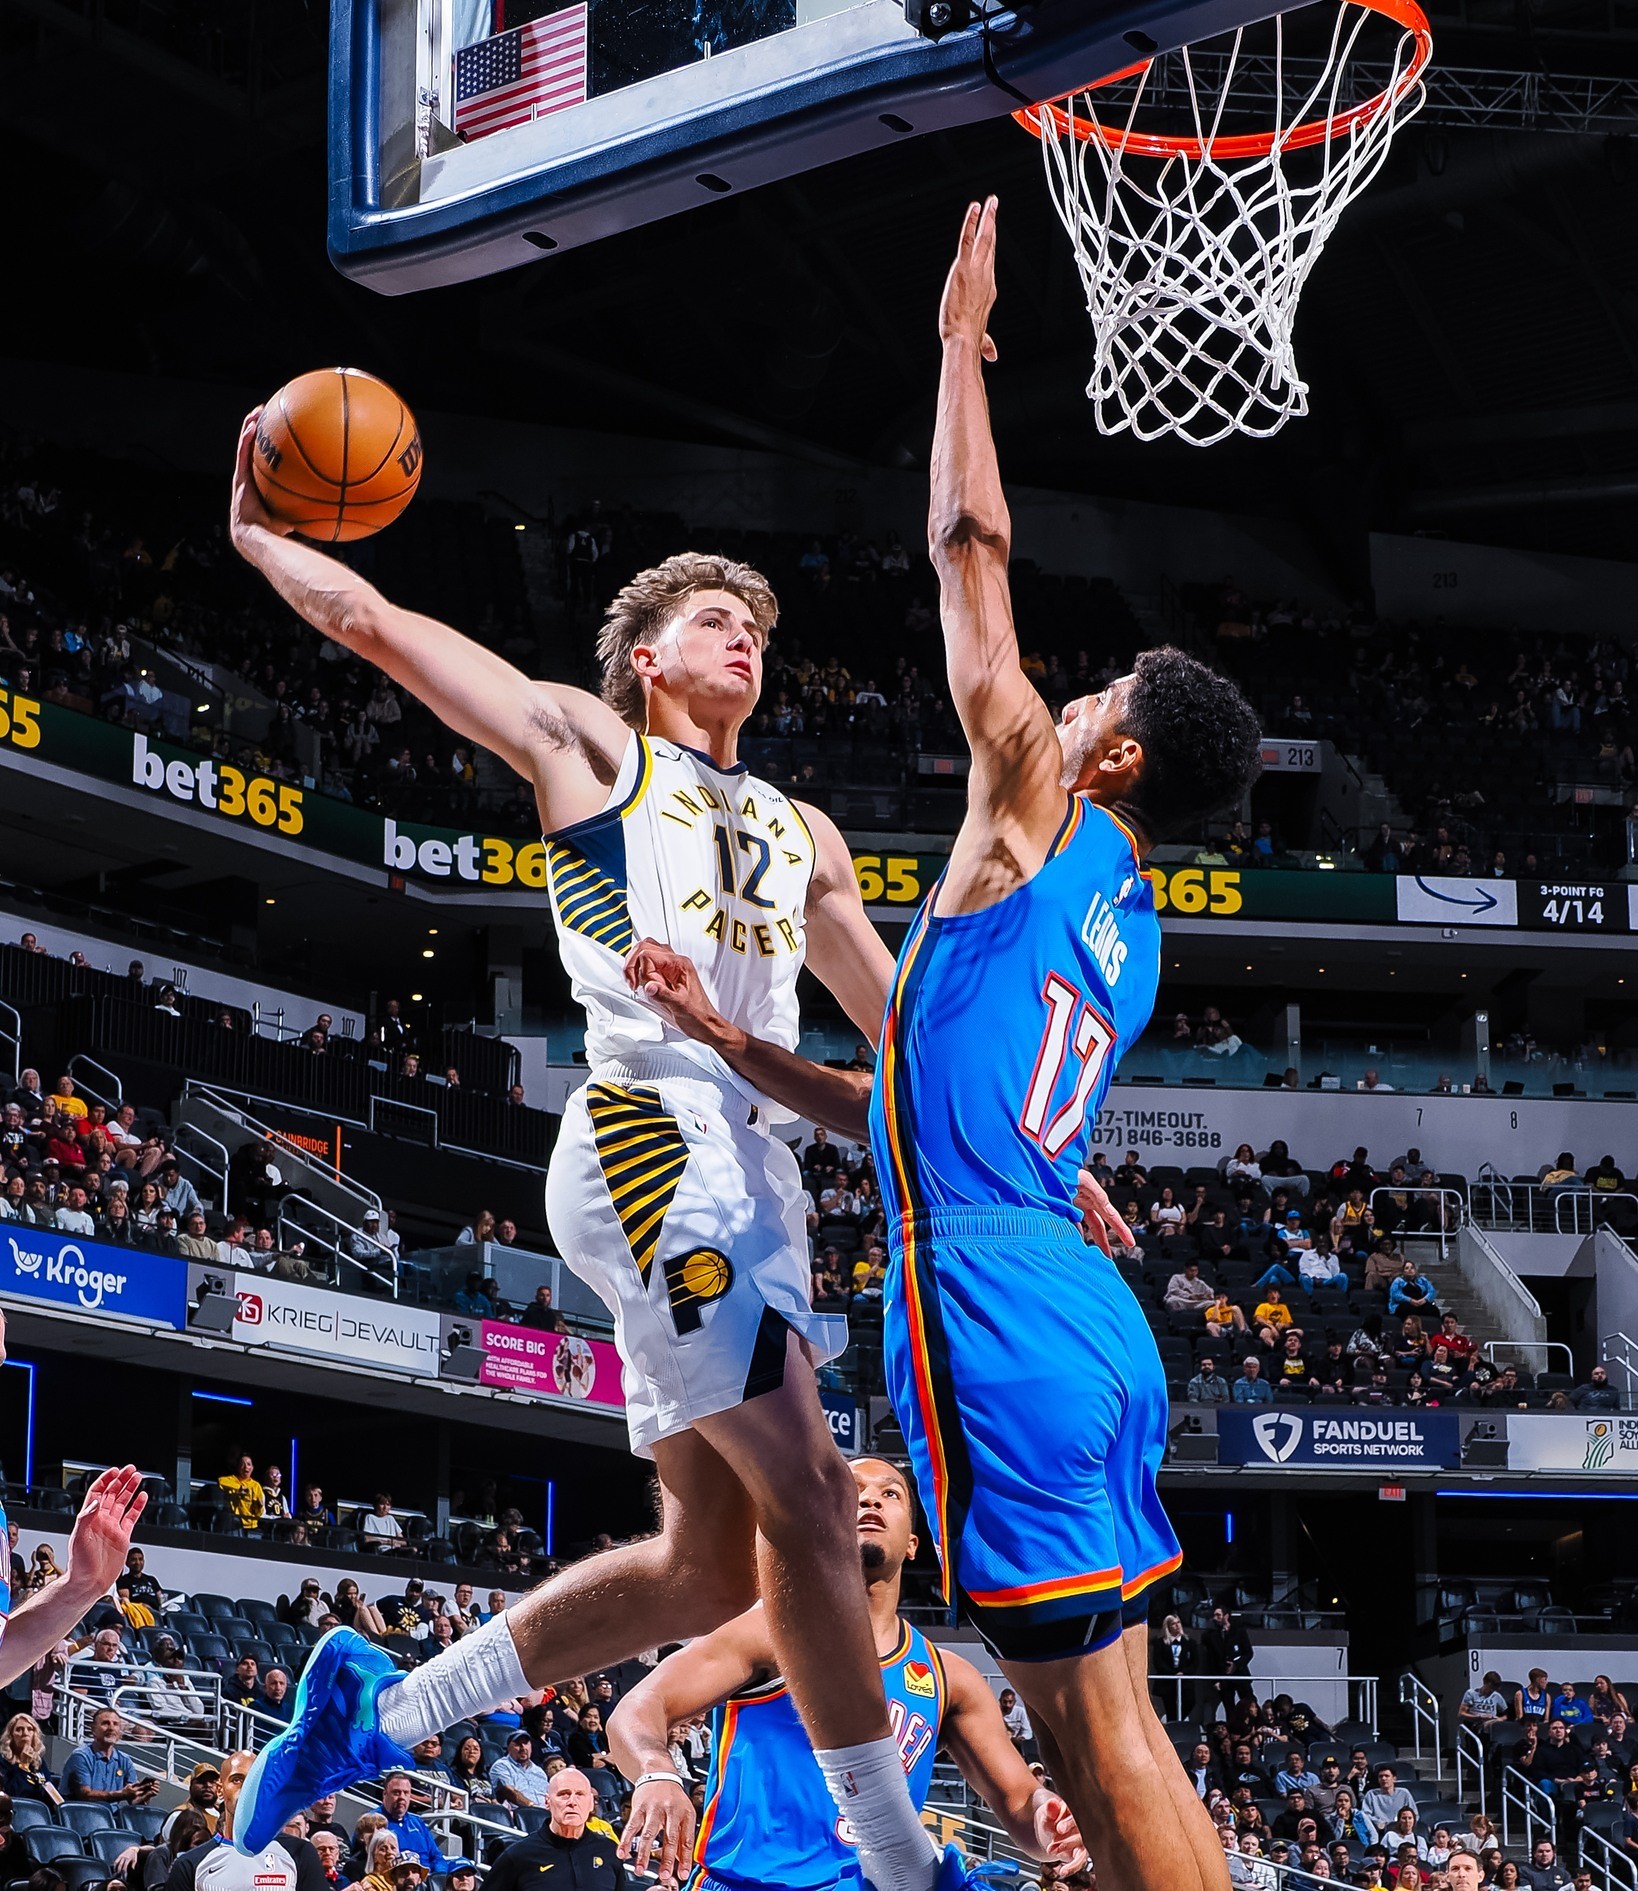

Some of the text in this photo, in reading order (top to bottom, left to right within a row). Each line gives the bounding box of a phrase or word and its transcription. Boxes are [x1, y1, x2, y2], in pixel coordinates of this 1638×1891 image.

[1433, 572, 1458, 588] 213
[1288, 747, 1314, 767] 213
[133, 733, 304, 835] bet365
[660, 784, 804, 866] INDIANA
[384, 817, 548, 888] bet36
[712, 823, 777, 910] 12
[852, 856, 920, 902] 65
[1540, 885, 1605, 898] 3-POINT FG
[679, 887, 800, 957] PACER
[1542, 899, 1605, 924] 4/14
[172, 967, 188, 988] 107
[341, 1015, 356, 1038] 107
[1020, 969, 1119, 1163] 17
[1416, 1107, 1423, 1127] 7
[1510, 1110, 1518, 1130] 8
[275, 1129, 329, 1155] GAINBRIDGE
[1127, 1129, 1222, 1149] 846-3688
[47, 1244, 127, 1309] Kroger
[267, 1304, 333, 1334] KRIEG
[486, 1332, 546, 1356] SCORE BIG
[1313, 1420, 1424, 1441] FANDUEL
[1313, 1443, 1425, 1456] SPORTS NETWORK
[1336, 1648, 1344, 1670] 7
[1471, 1650, 1480, 1672] 8
[254, 1875, 286, 1886] Emirates
